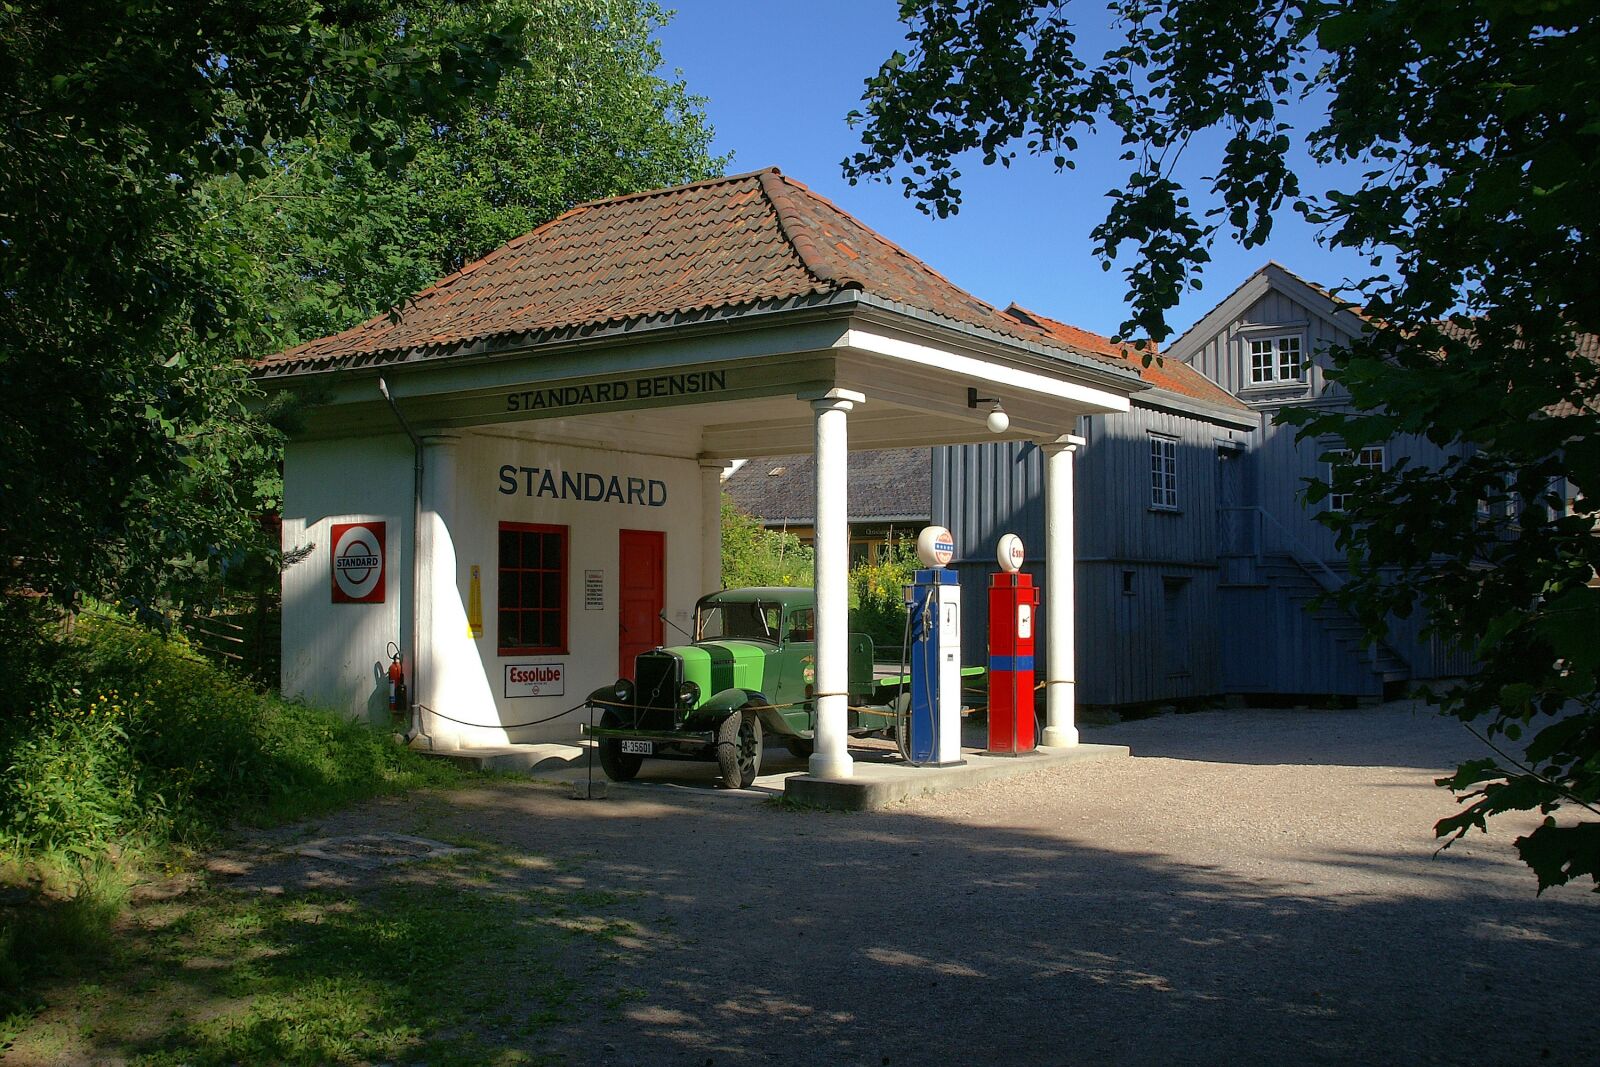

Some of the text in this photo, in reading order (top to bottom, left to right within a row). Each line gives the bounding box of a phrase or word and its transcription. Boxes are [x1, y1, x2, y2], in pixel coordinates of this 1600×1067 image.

[507, 370, 726, 412] STANDARD BENSIN
[498, 464, 667, 507] STANDARD
[336, 557, 379, 568] STANDARD
[510, 667, 561, 683] Essolube
